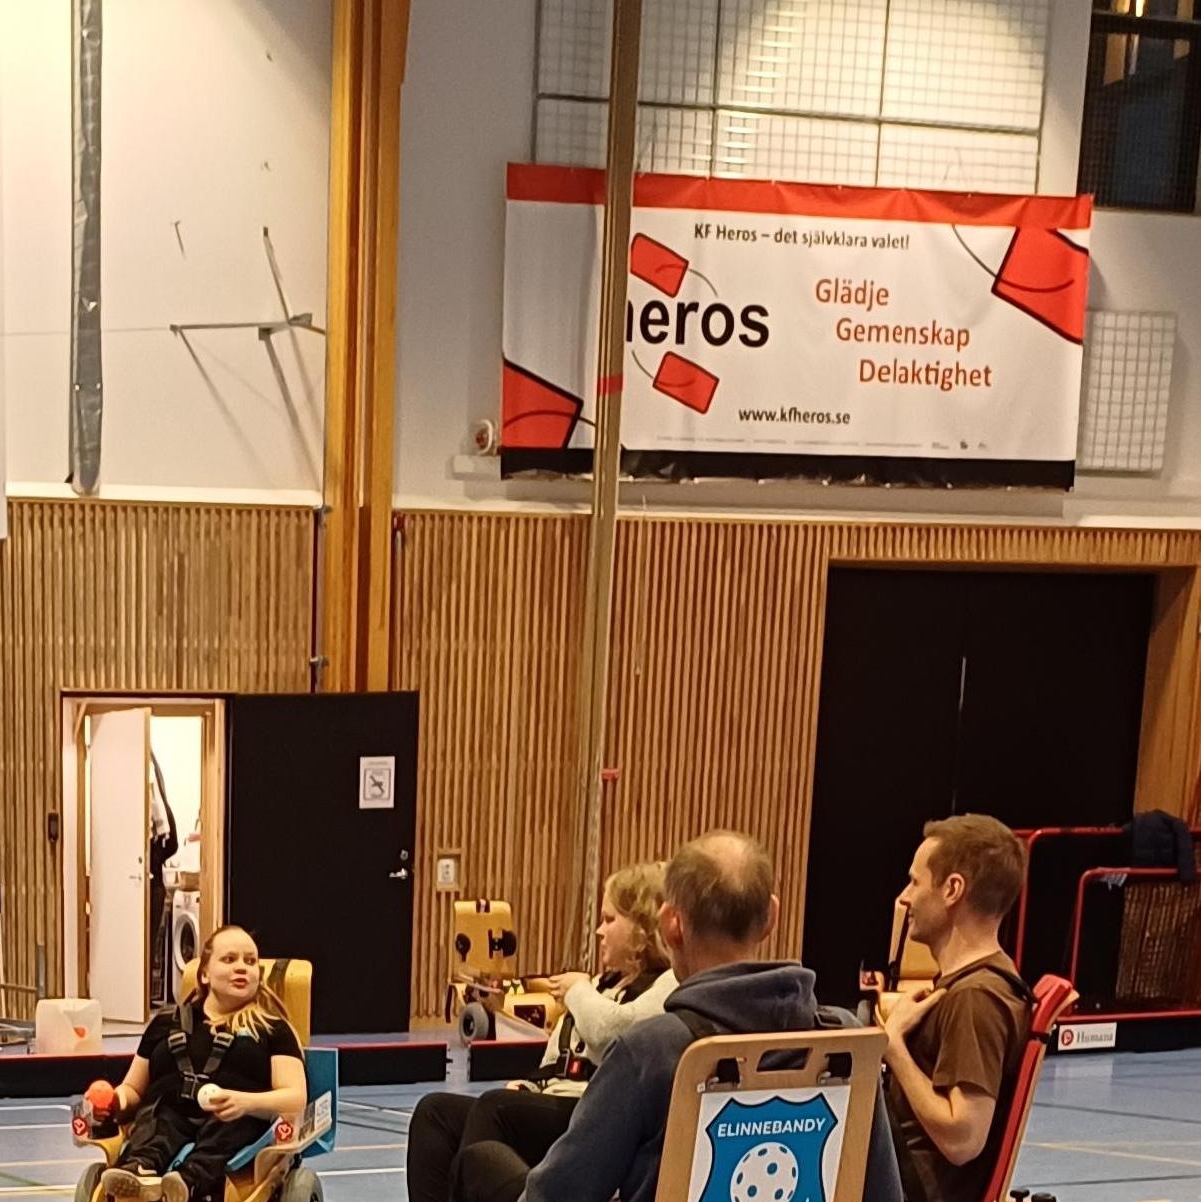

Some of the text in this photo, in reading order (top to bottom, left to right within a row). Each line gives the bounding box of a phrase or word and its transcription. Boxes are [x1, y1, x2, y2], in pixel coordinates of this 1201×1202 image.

[694, 223, 712, 240] KF
[715, 226, 758, 243] Heros
[774, 229, 798, 244] det
[802, 229, 868, 249] självklara
[871, 234, 910, 250] valet!
[815, 278, 890, 311] Glädje
[626, 299, 771, 348] eros
[836, 317, 971, 353] Gemenskap
[859, 358, 992, 392] Delaktighet
[738, 406, 851, 425] www.kfheros.se
[717, 1118, 826, 1138] ELINNEBANDY
